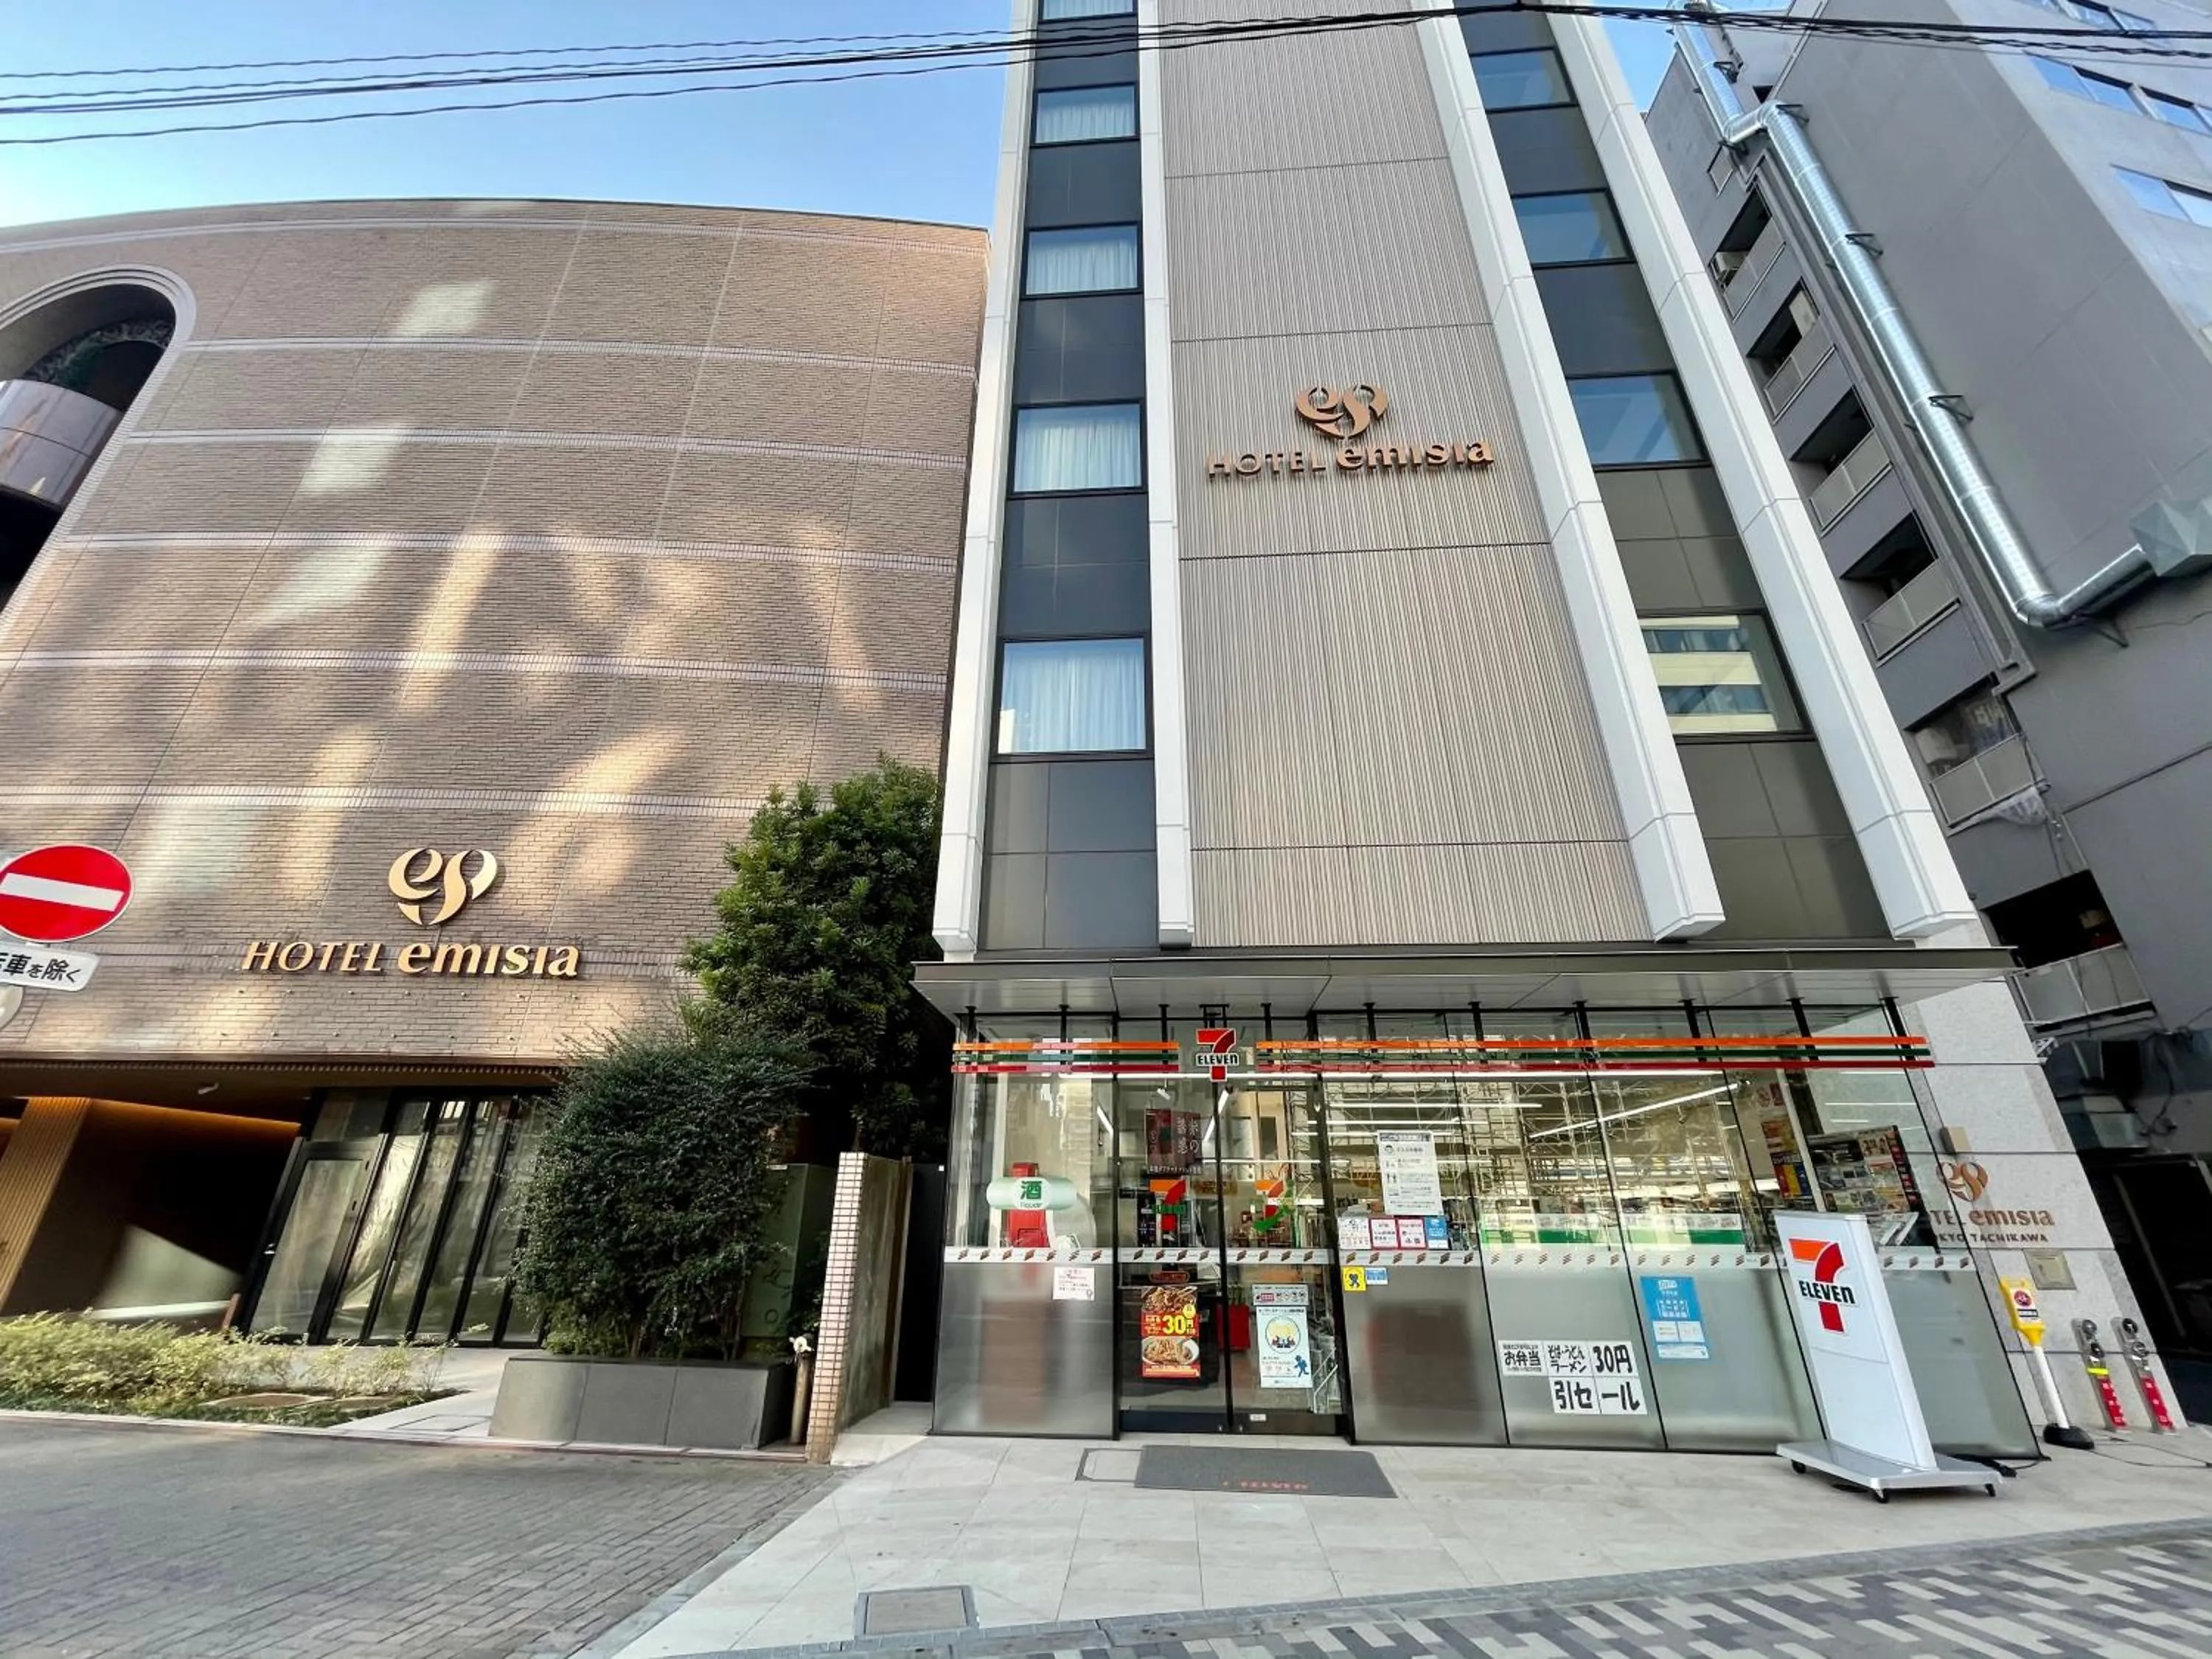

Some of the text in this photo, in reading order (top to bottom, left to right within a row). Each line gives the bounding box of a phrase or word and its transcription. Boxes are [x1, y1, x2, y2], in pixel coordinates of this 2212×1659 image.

[1206, 440, 1495, 478] HOTEL emisia
[241, 941, 580, 977] HOTEL emisia
[1020, 1180, 1042, 1200] 酒
[1968, 1210, 2056, 1226] emisia
[1969, 1234, 2049, 1242] TACHIKAWA
[1551, 1360, 1587, 1374] ラーメン
[1592, 1344, 1633, 1374] 30円
